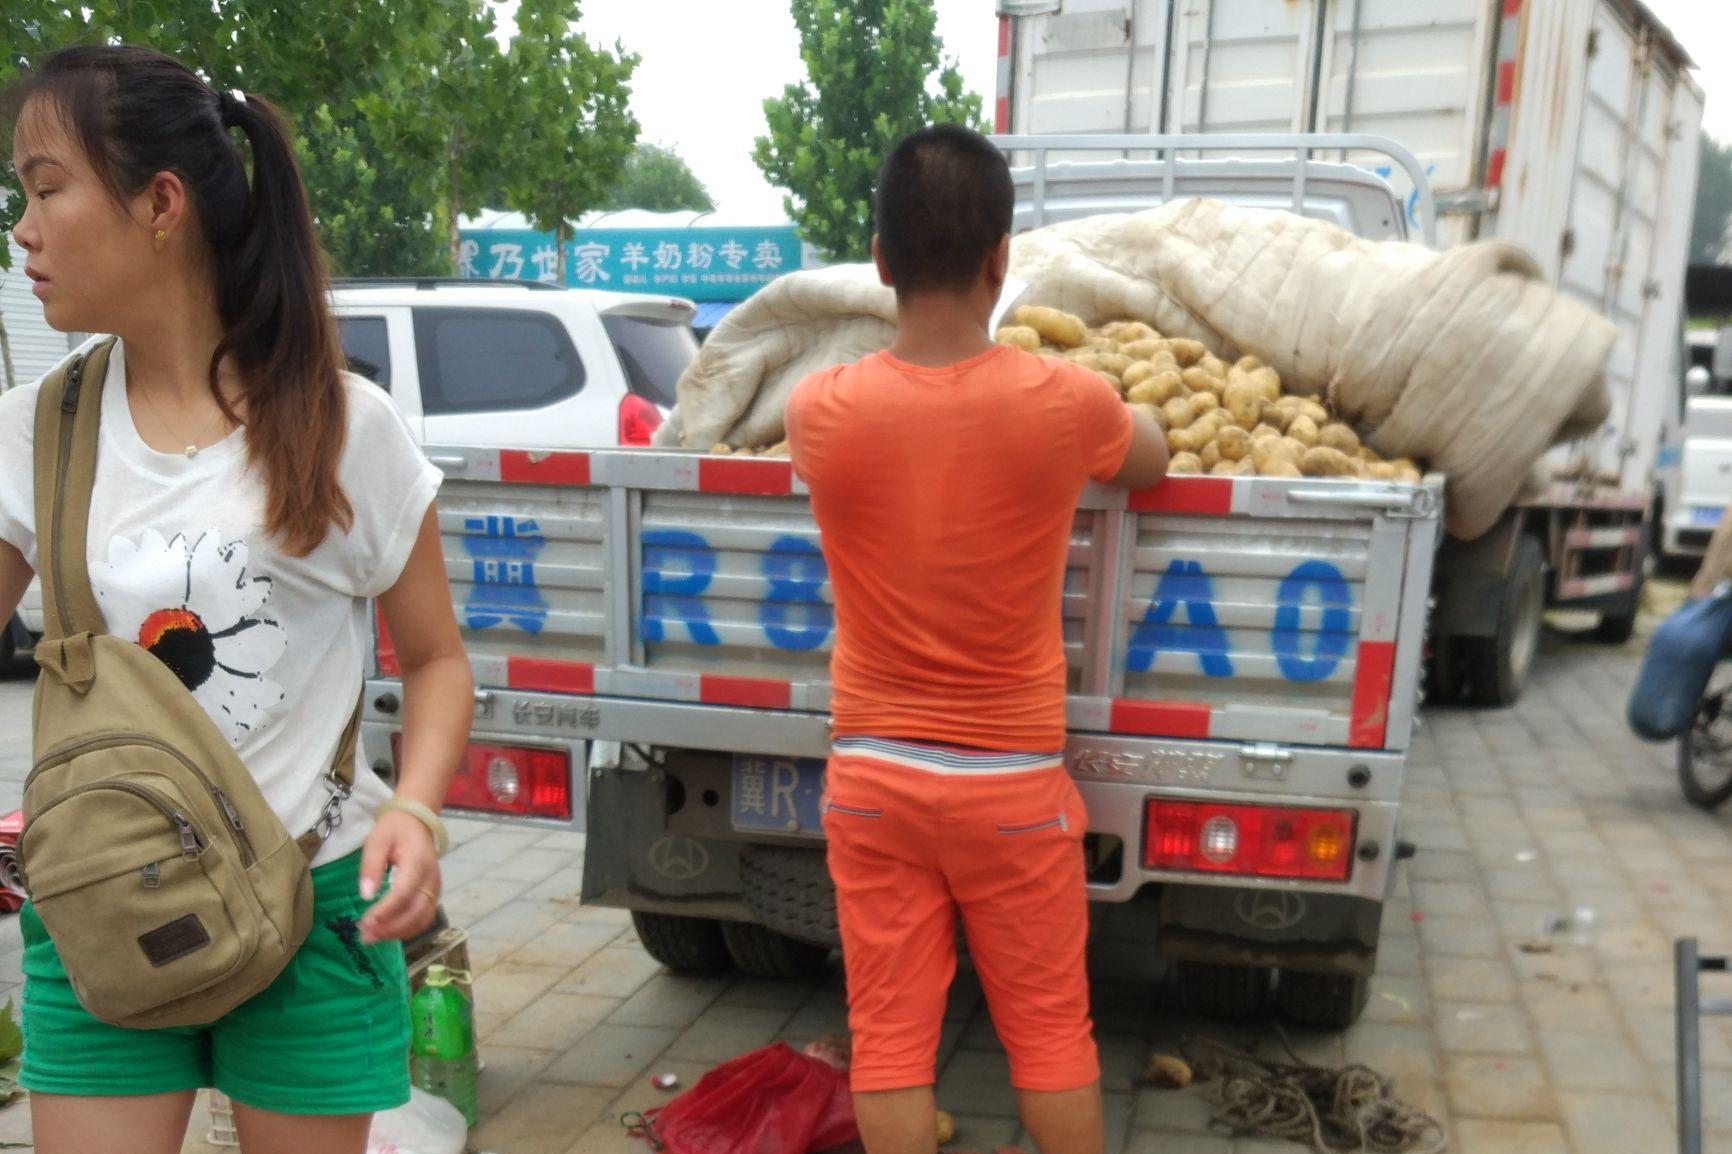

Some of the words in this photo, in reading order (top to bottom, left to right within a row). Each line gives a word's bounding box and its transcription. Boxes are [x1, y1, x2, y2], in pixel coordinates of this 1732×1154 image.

[620, 240, 783, 270] 羊奶粉专卖
[461, 515, 549, 634] 冀
